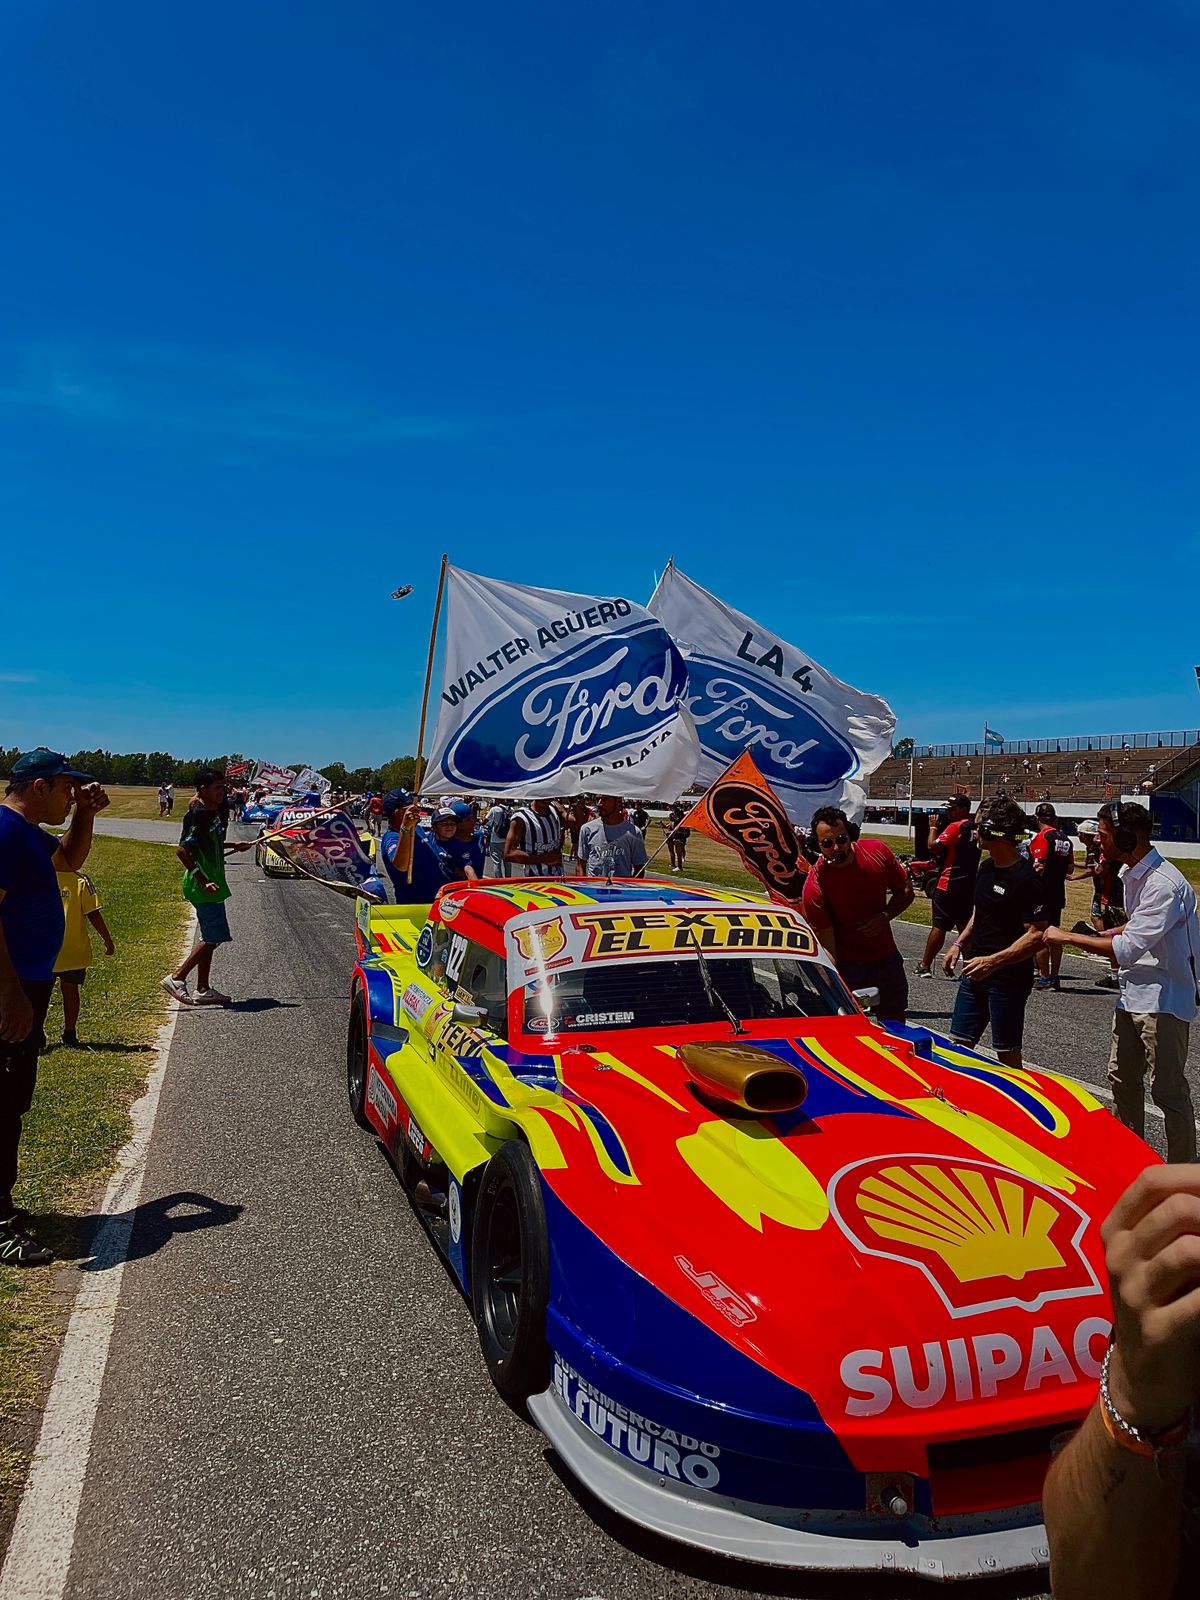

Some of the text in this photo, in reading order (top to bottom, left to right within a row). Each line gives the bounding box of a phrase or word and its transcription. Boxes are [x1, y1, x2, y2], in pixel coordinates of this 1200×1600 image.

[441, 597, 632, 708] WALTER AGÜERO
[736, 630, 814, 693] LA 4
[515, 646, 680, 772] Ford
[688, 677, 820, 770] Ford
[578, 729, 673, 782] LA PLATA
[723, 801, 797, 885] Ford
[584, 913, 809, 932] TEXTIL
[597, 928, 811, 954] EL LLANO
[575, 1011, 635, 1024] CRISTEM
[675, 1256, 755, 1321] JG
[553, 1363, 721, 1489] EL FUTURO
[554, 1350, 721, 1458] SUPERMERCADO
